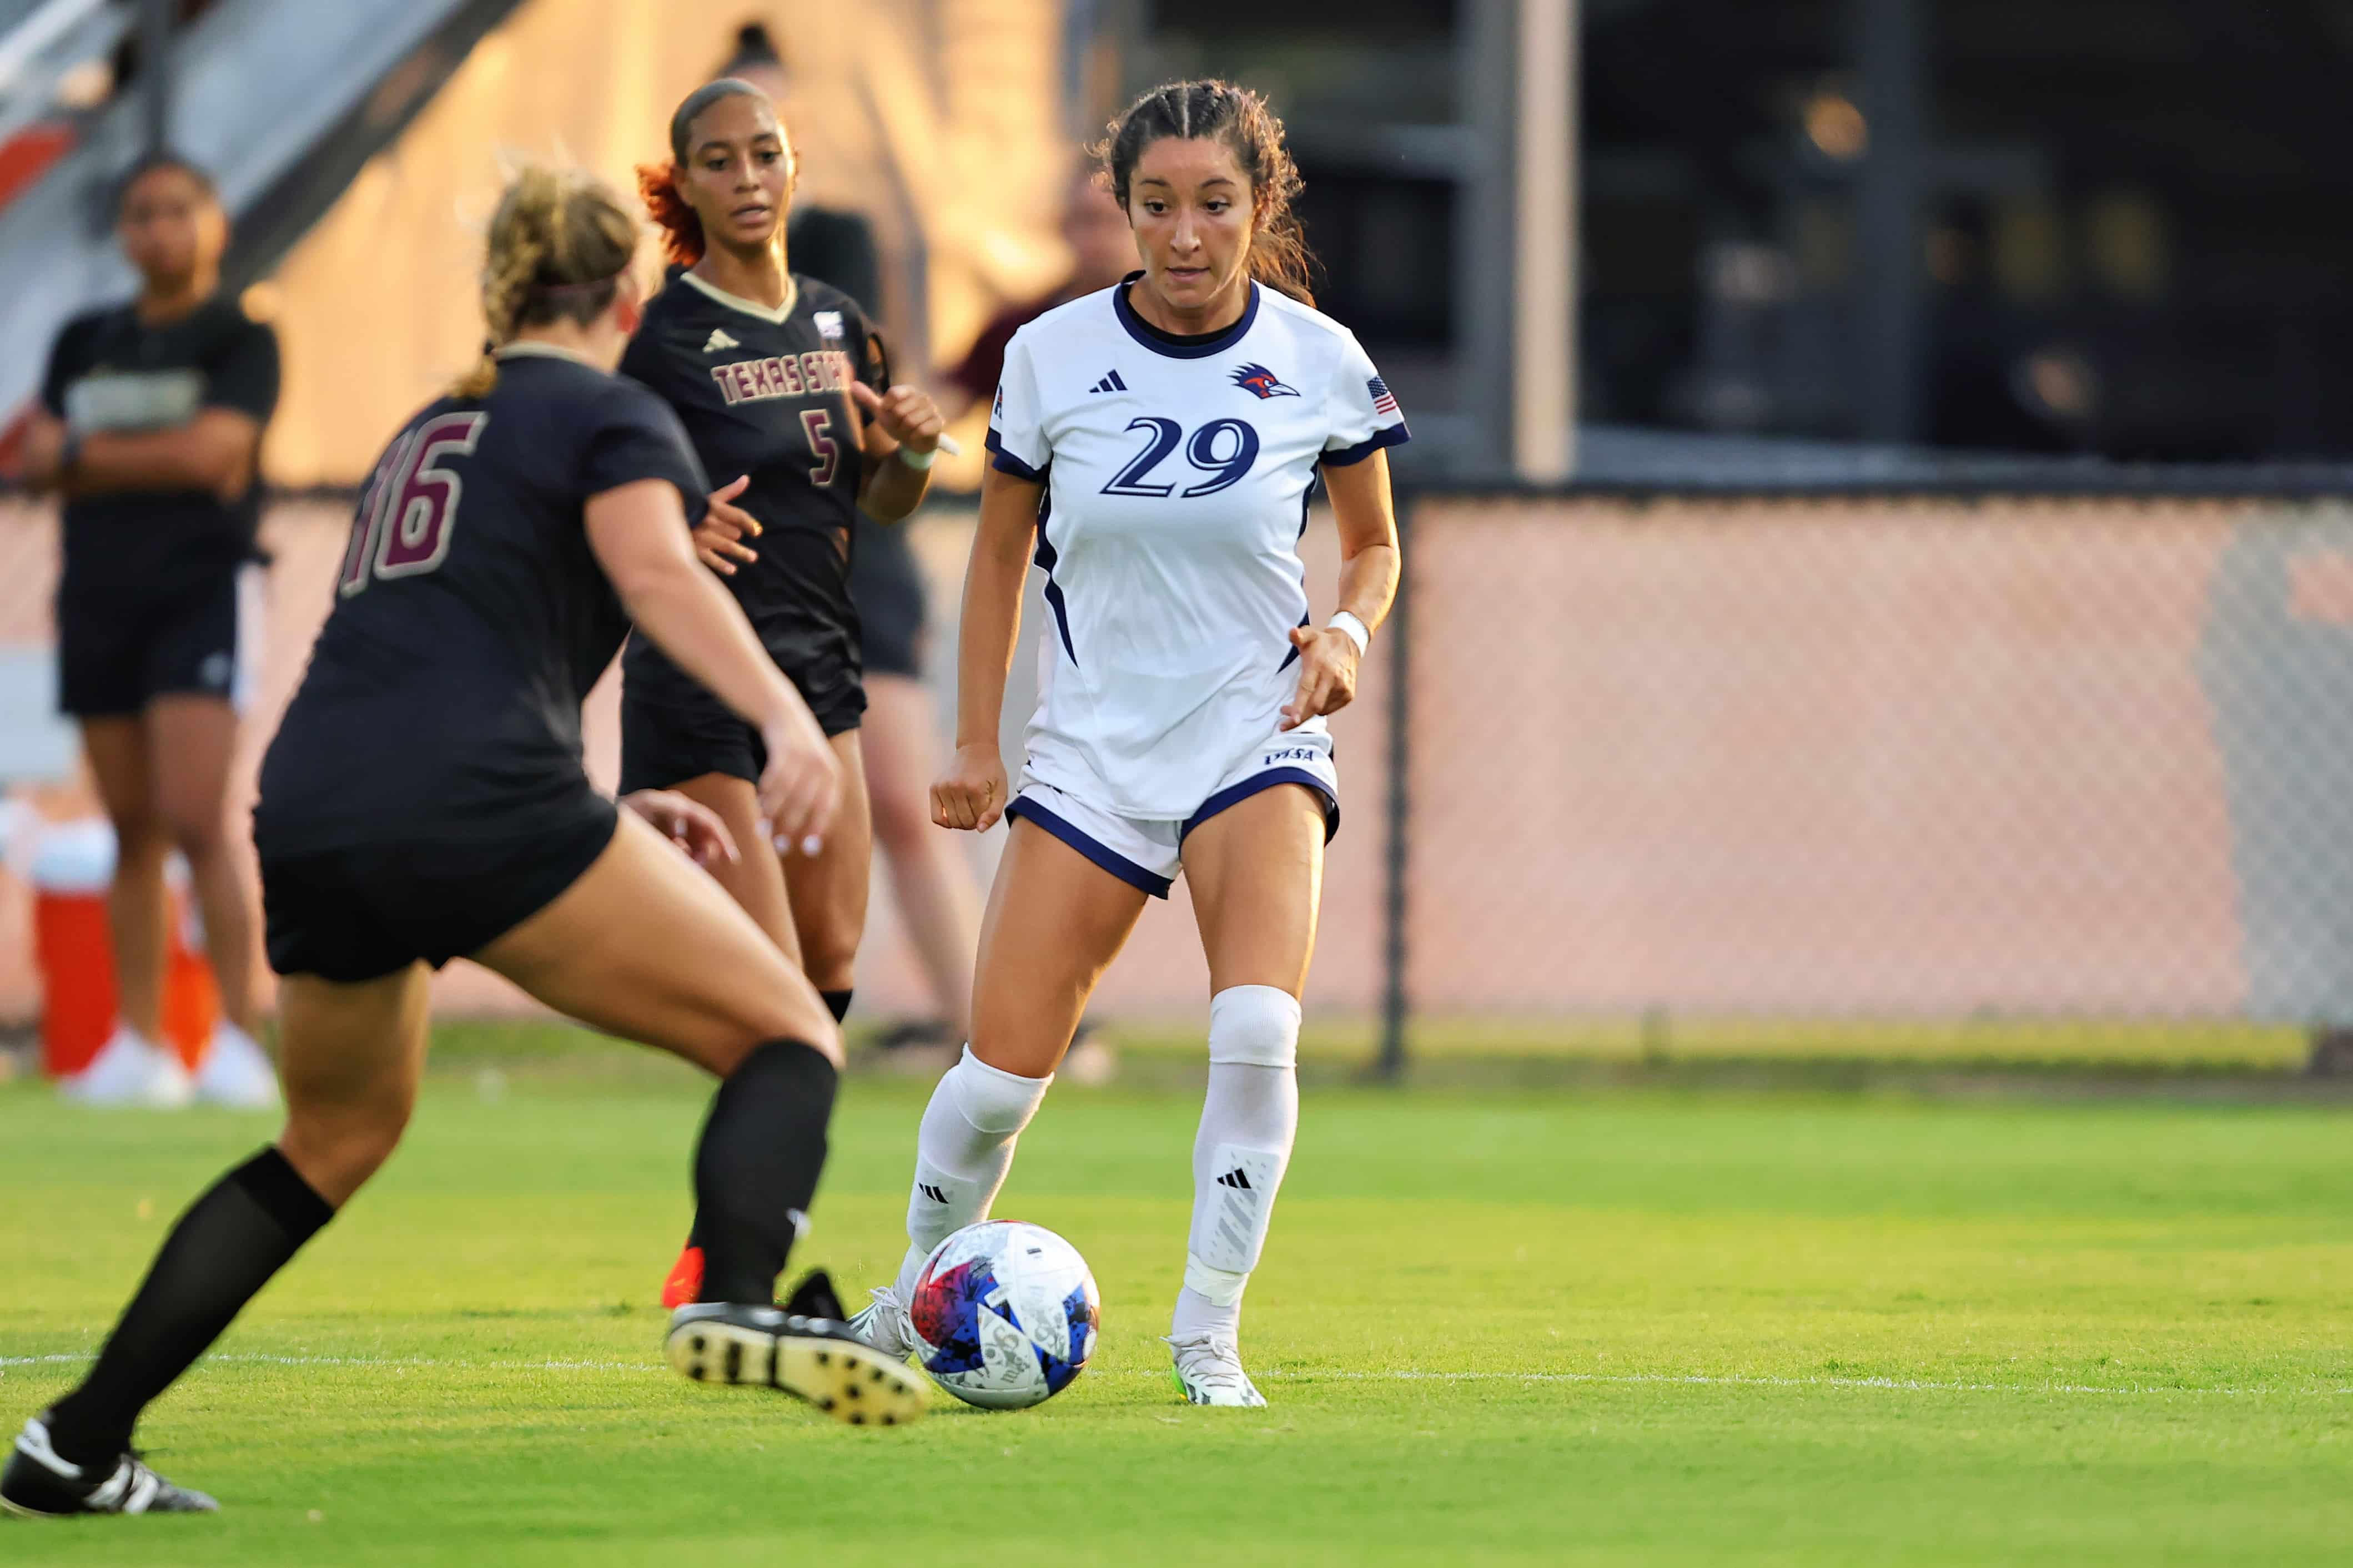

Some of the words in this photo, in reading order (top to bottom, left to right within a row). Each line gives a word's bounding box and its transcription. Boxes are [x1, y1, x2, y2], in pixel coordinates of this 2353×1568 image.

[711, 354, 805, 406] TEXAS
[800, 350, 848, 393] STA
[800, 409, 838, 486] 5
[1099, 417, 1260, 498] 29
